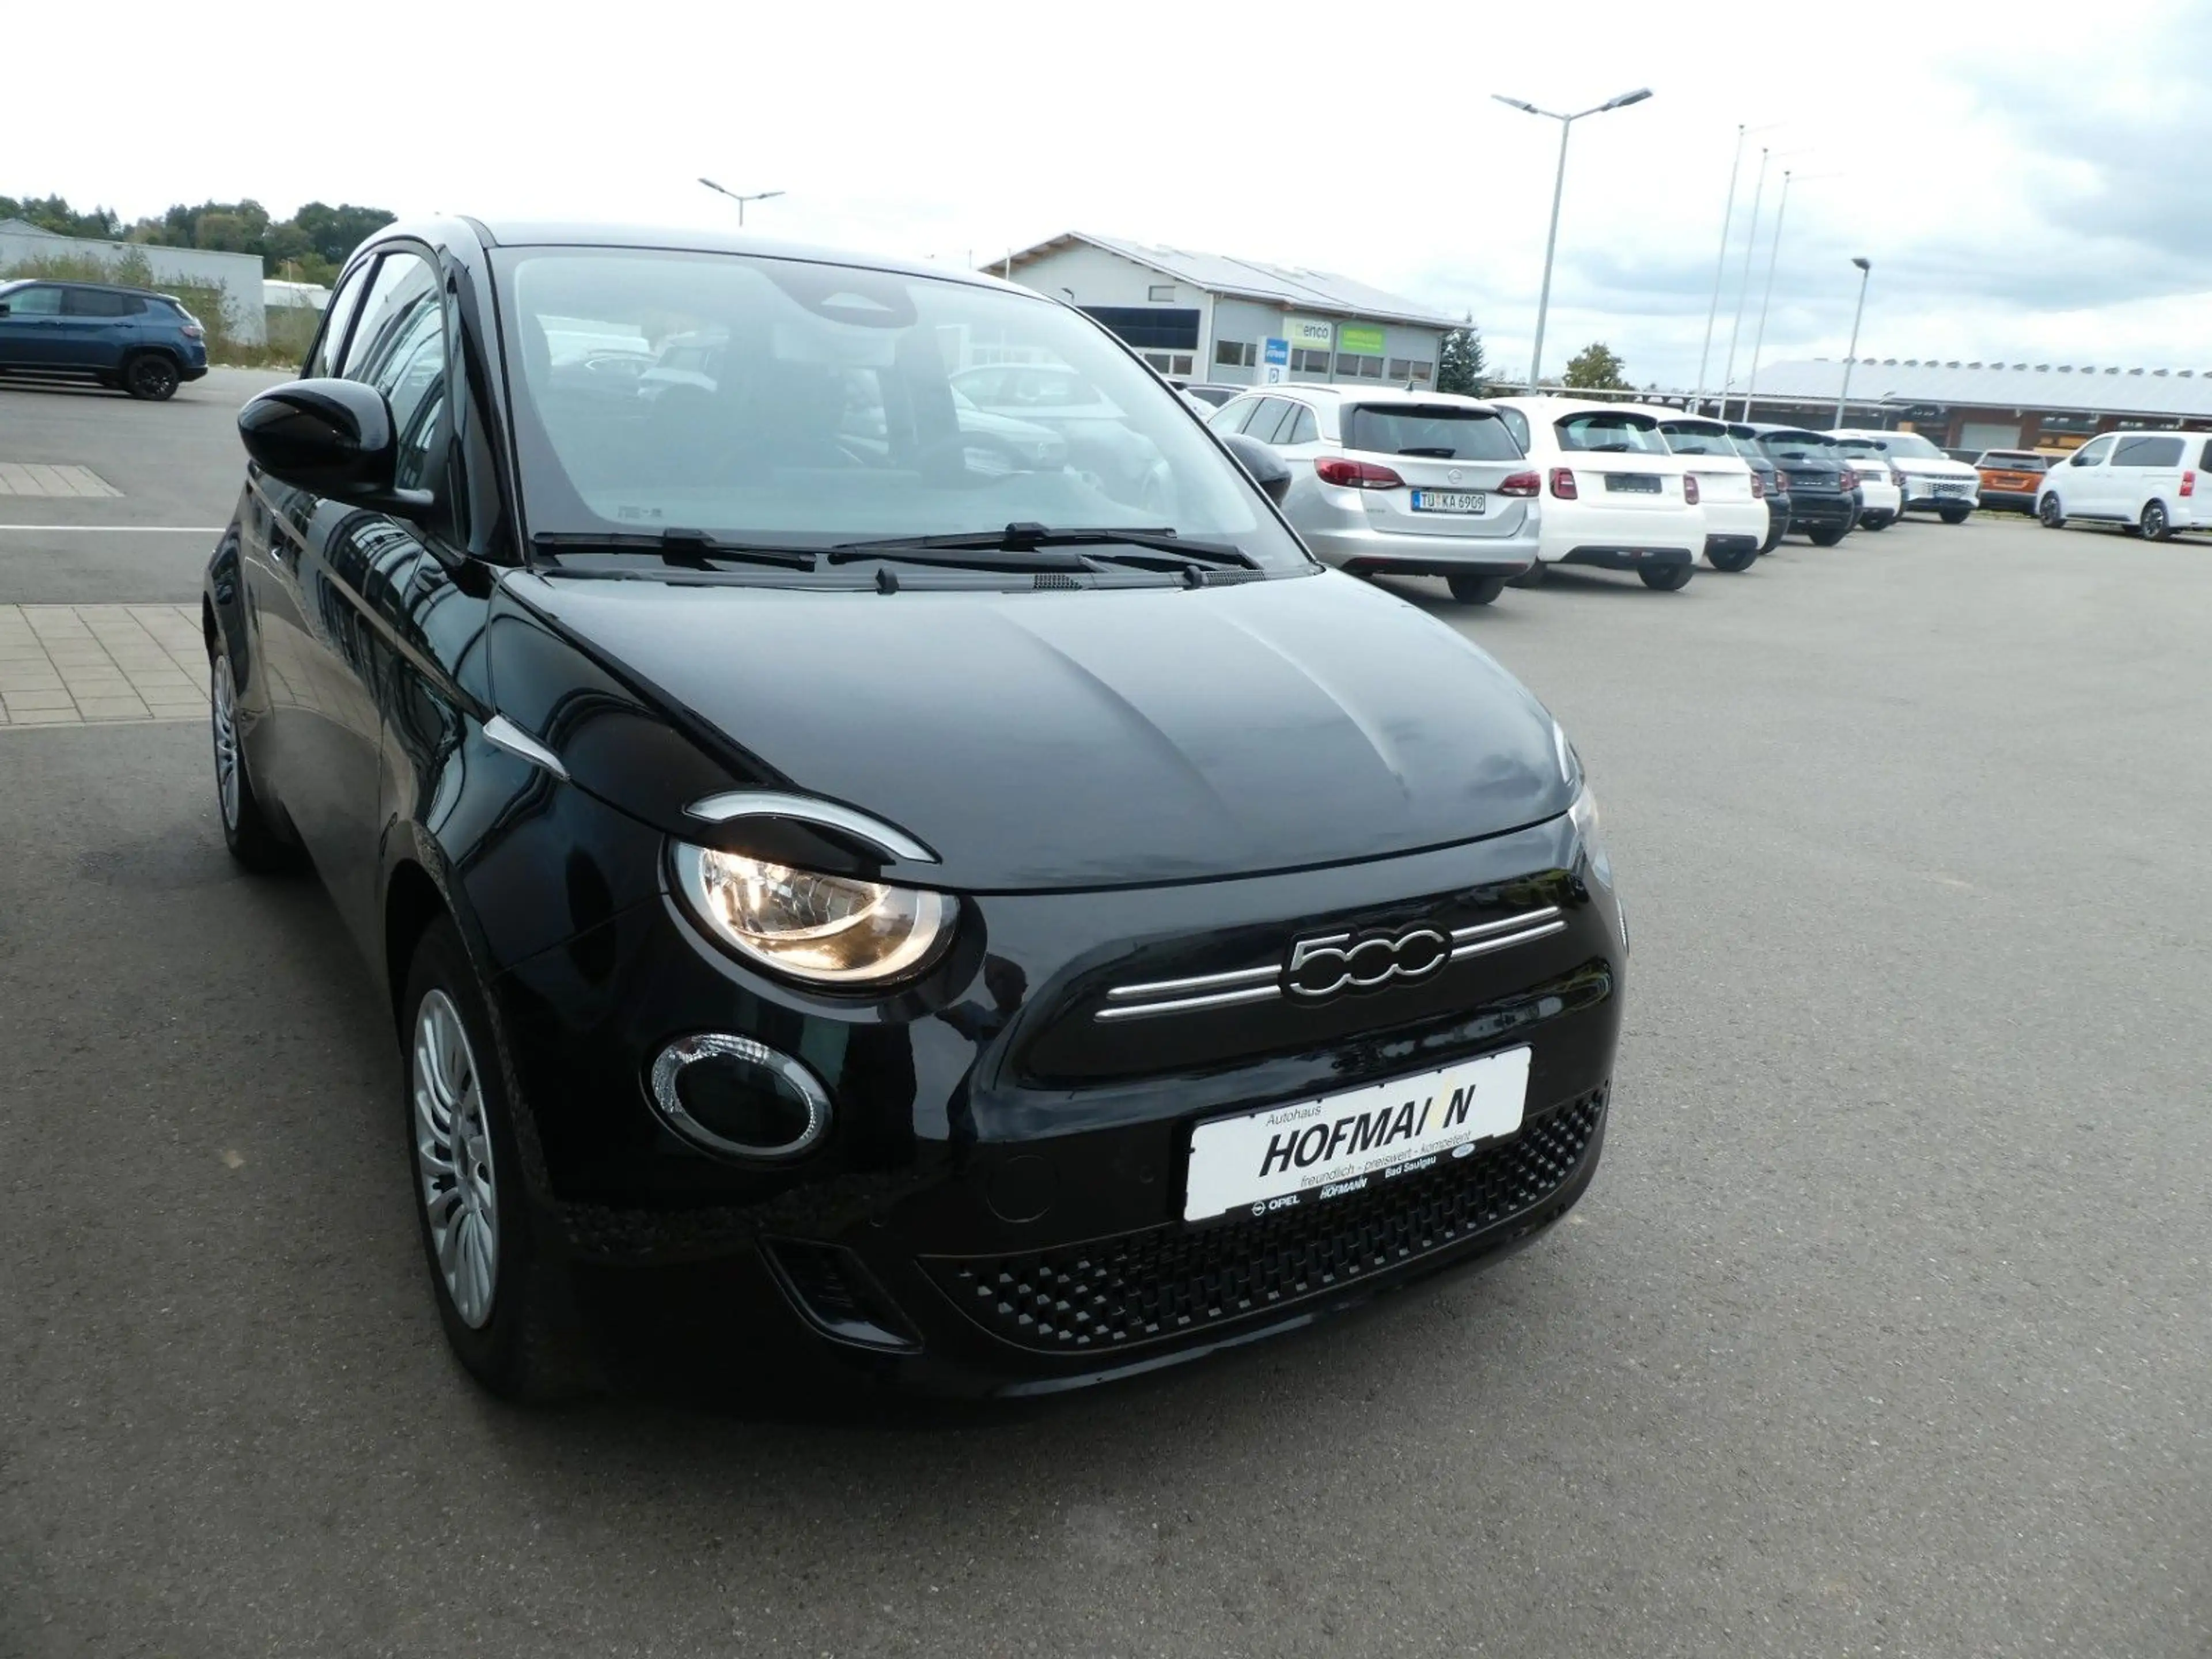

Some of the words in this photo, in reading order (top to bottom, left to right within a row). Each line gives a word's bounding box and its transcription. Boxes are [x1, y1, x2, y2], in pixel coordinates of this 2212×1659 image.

[1442, 494, 1455, 508] KA
[1459, 495, 1483, 509] 6909
[1289, 929, 1445, 996] 500
[1266, 1106, 1321, 1126] Autohaus
[1300, 1162, 1354, 1188] freundlich
[1363, 1148, 1412, 1173] preiswert
[1421, 1130, 1471, 1153] kompetent
[1385, 1165, 1403, 1179] Bad
[1268, 1194, 1301, 1210] OPEL
